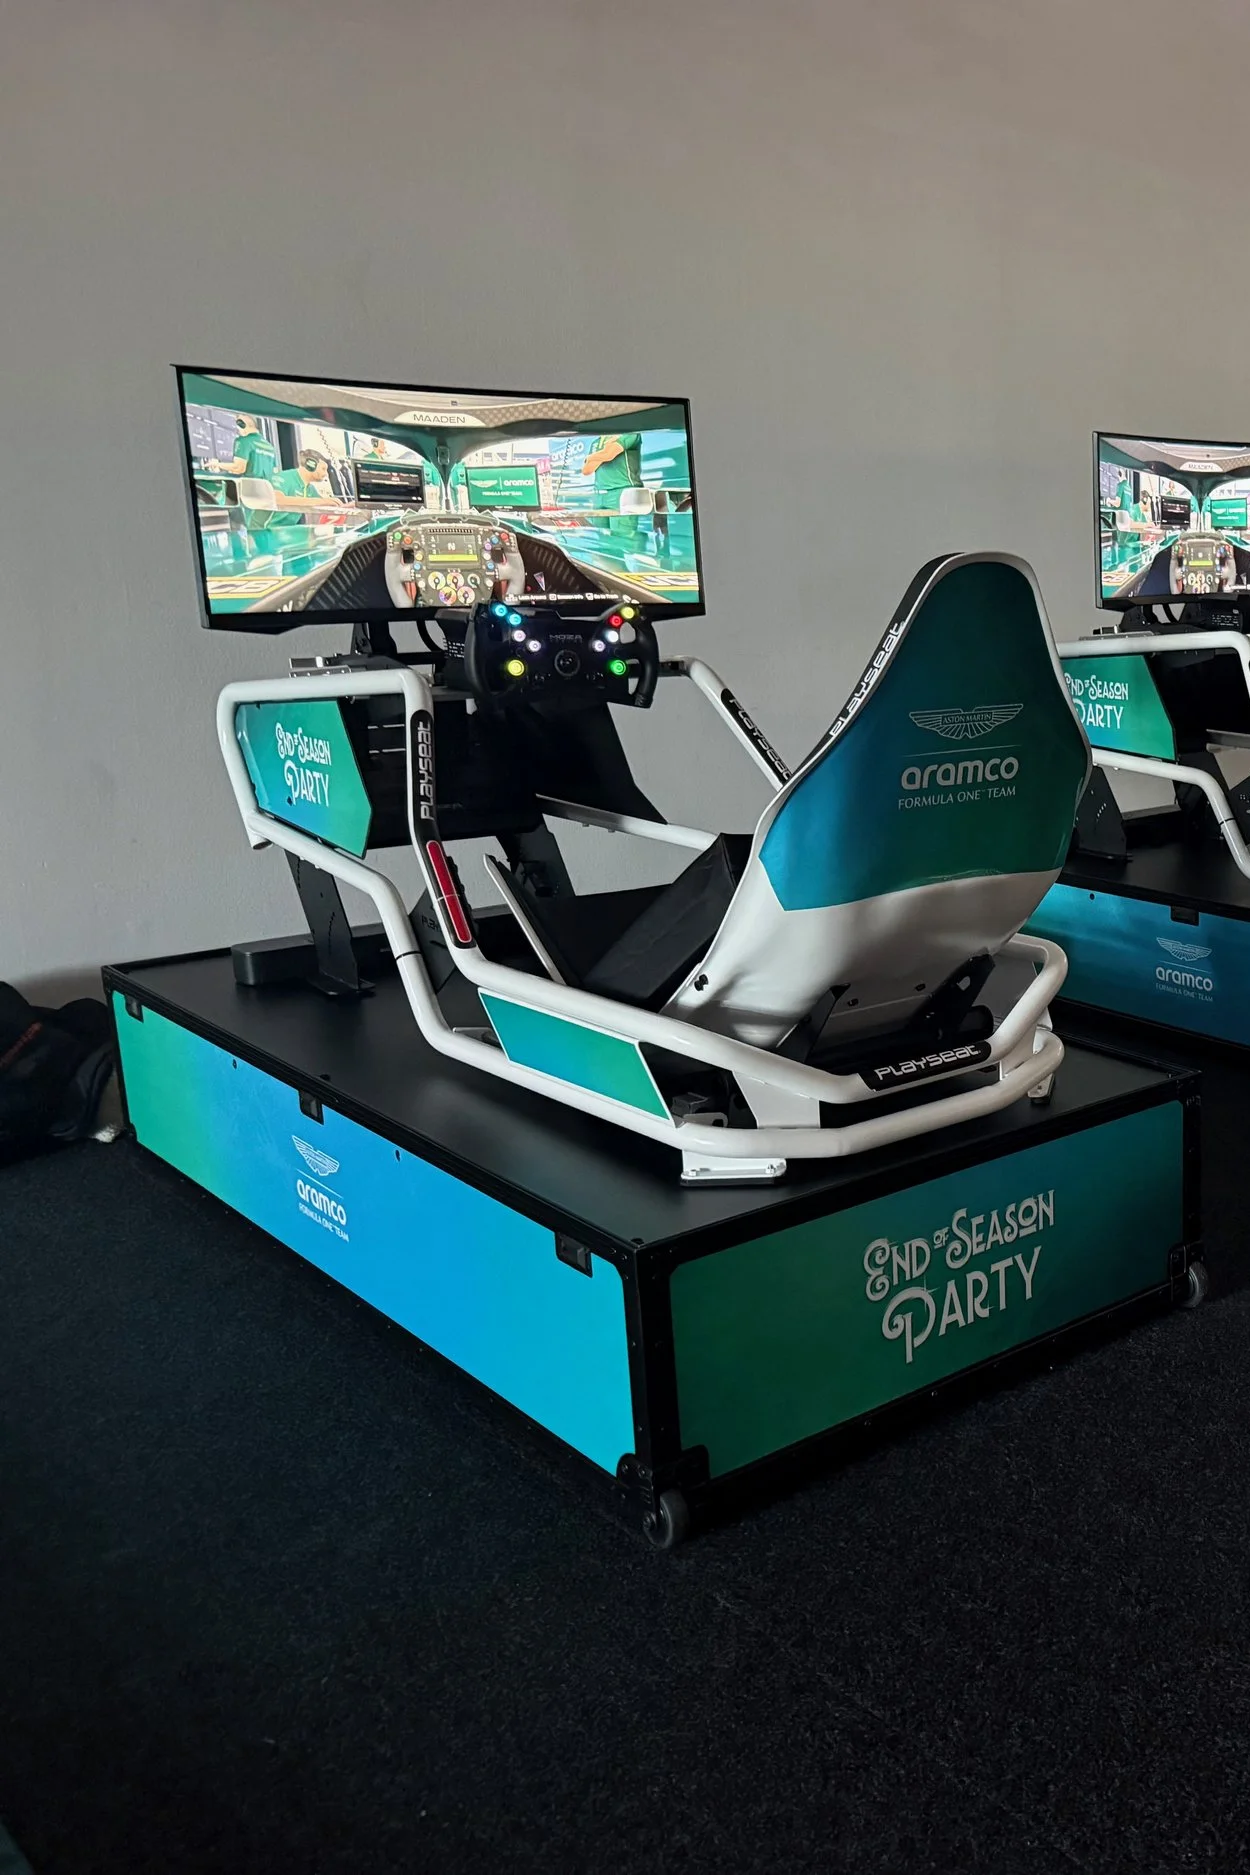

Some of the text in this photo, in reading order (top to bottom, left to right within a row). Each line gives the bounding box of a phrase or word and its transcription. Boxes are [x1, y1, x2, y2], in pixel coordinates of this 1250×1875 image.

[413, 413, 466, 424] MAADEN
[1088, 674, 1129, 700] SEASON
[942, 713, 992, 724] ASTON MARTIN
[275, 722, 295, 759] END
[298, 726, 332, 766] SEASON
[284, 759, 329, 807] PARTY
[901, 756, 1019, 790] aramco
[898, 793, 954, 810] FORMULA
[987, 786, 1016, 798] TEAM
[1156, 966, 1213, 991] aramco
[296, 1179, 347, 1226] aramco
[335, 1226, 350, 1243] TEAM
[863, 1190, 1055, 1302] END OF SEASON
[881, 1246, 1043, 1364] PARTY
